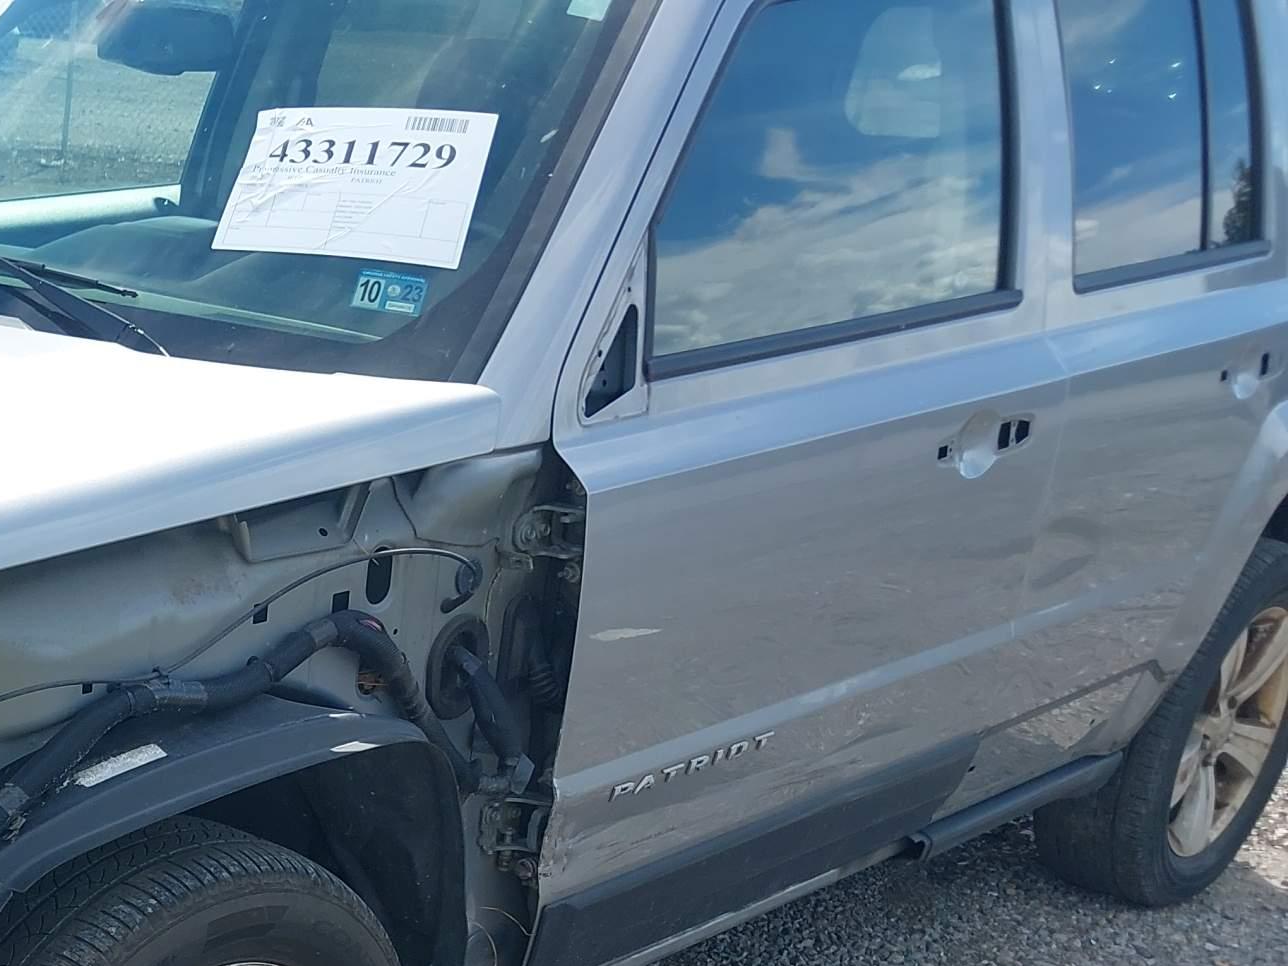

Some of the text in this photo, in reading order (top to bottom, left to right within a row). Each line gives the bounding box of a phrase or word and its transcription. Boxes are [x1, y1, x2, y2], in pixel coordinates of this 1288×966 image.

[268, 138, 457, 170] 43311729
[360, 278, 424, 303] 10 23
[608, 730, 775, 802] PATRIOT
